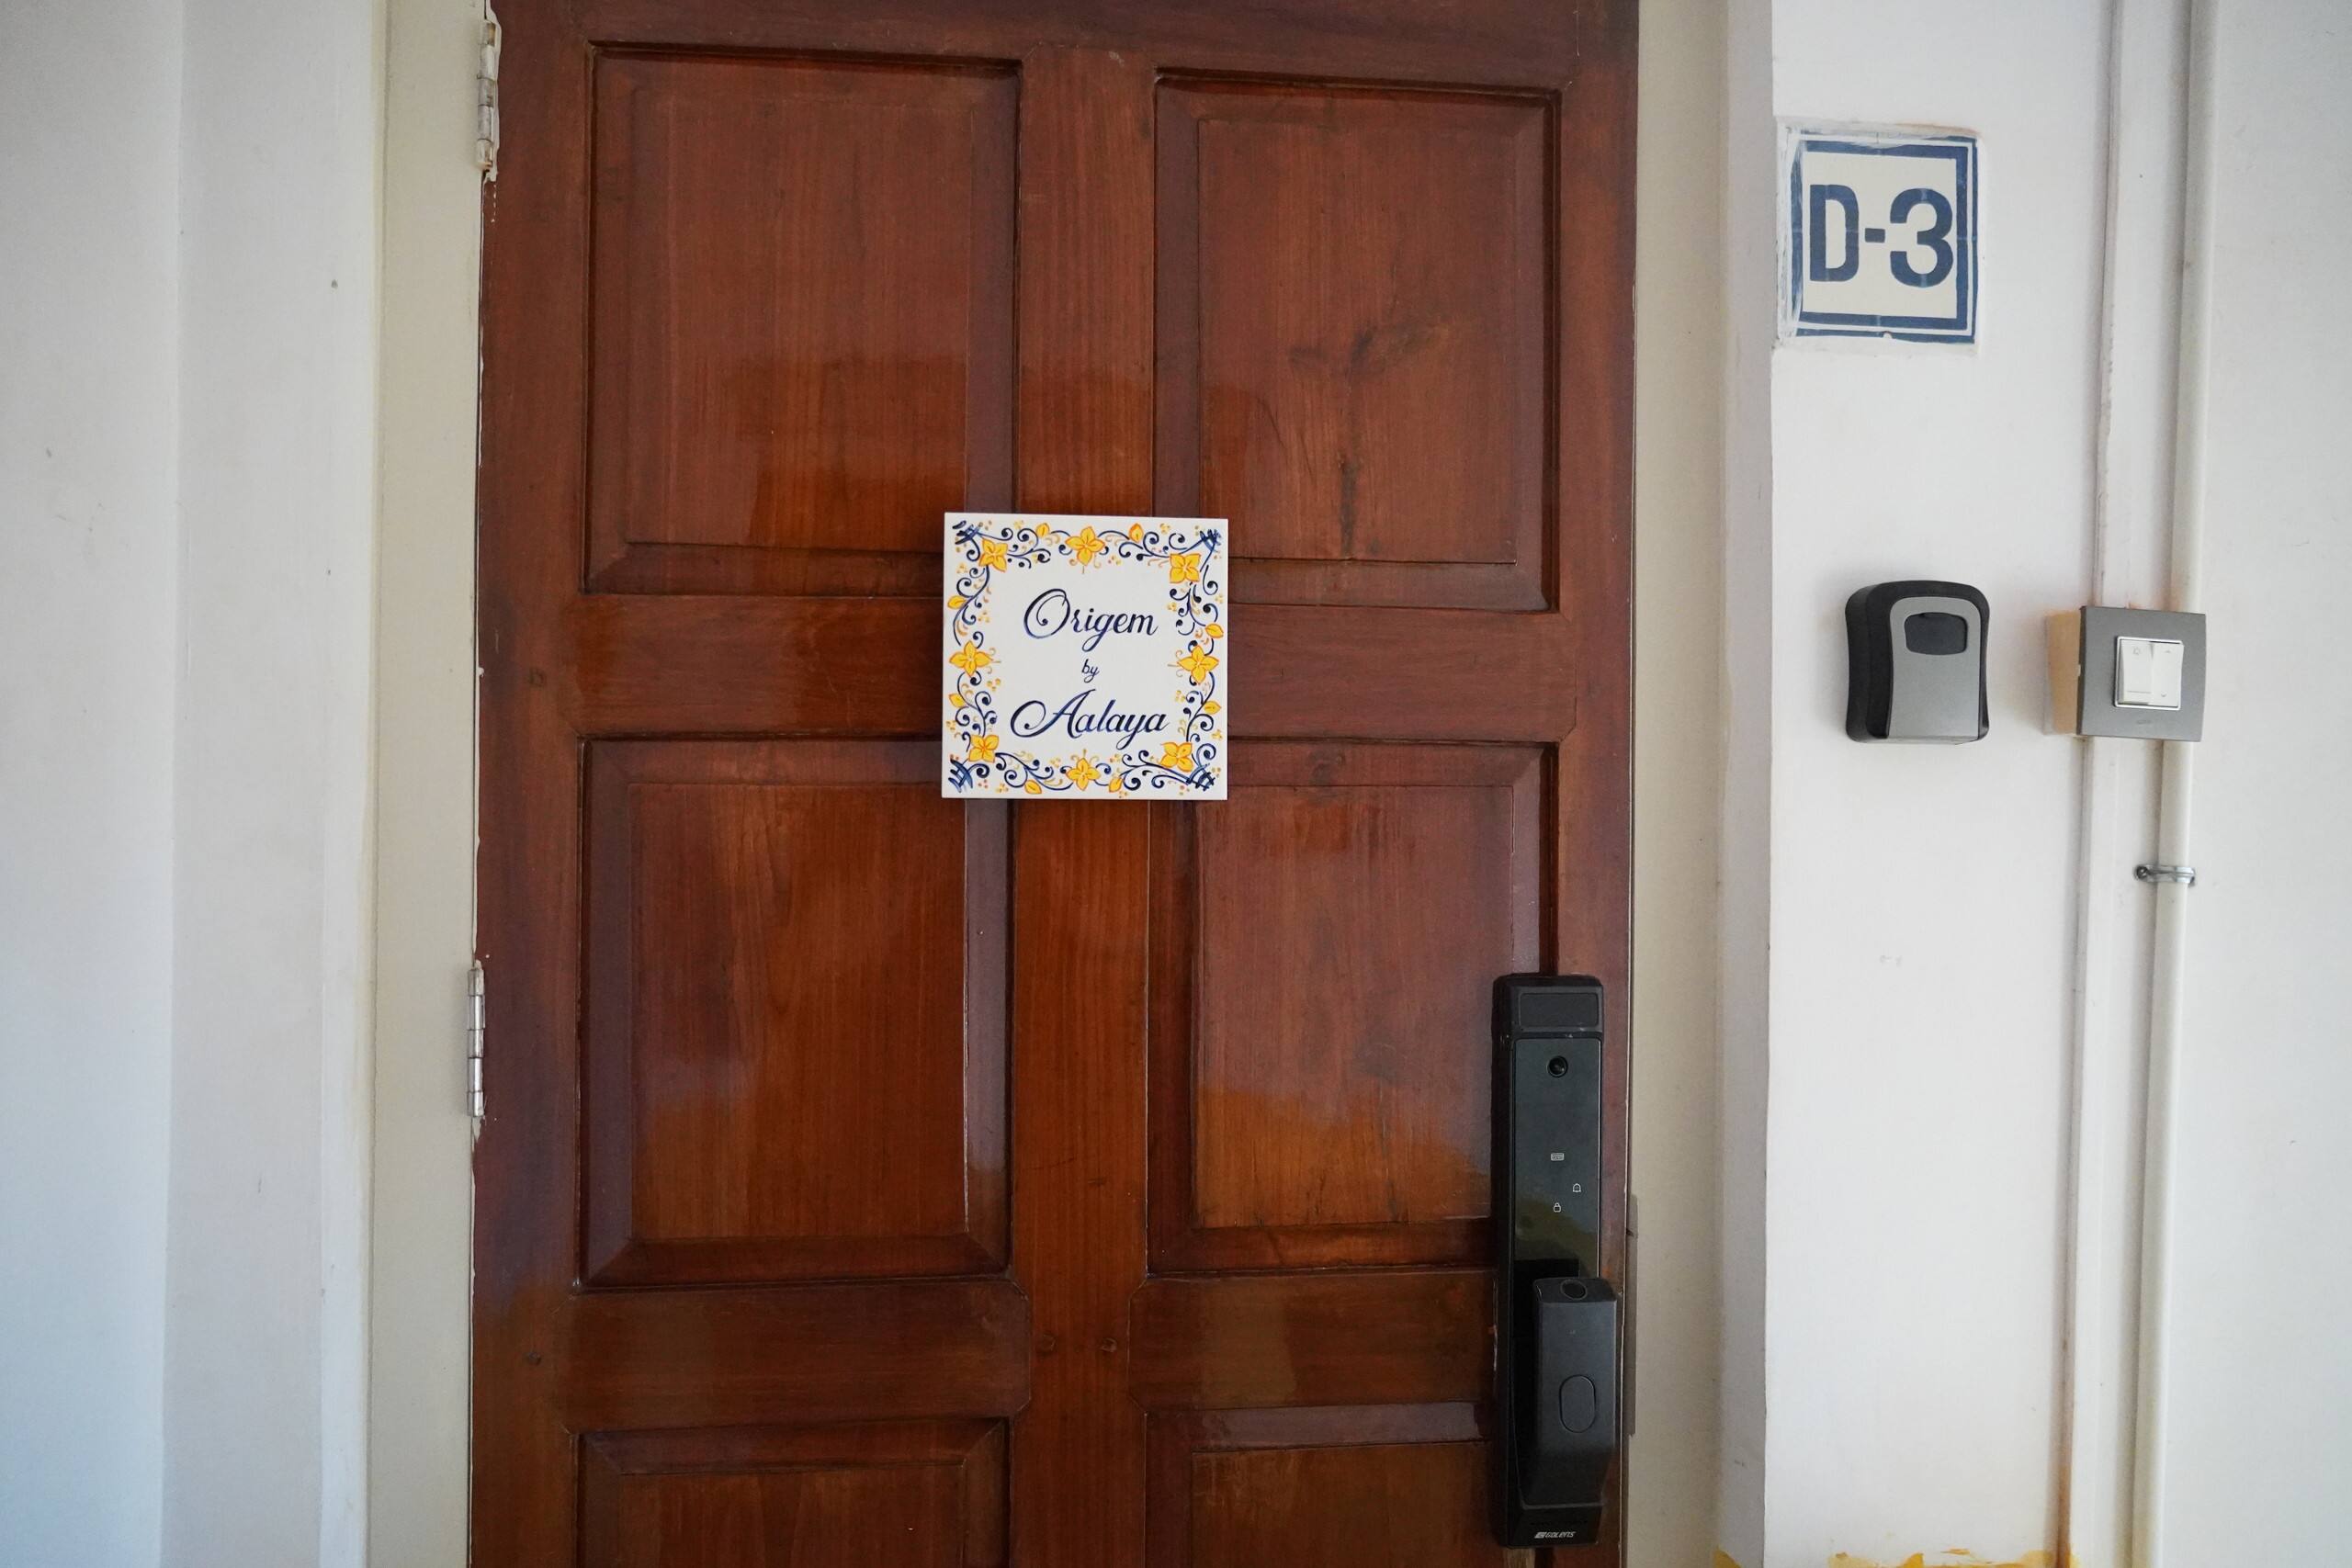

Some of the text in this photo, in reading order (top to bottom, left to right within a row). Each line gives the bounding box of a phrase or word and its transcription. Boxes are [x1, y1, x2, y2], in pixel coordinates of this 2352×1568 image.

[1809, 185, 1953, 288] D-3
[1023, 588, 1159, 652] Origem
[1081, 659, 1100, 683] by
[1011, 689, 1170, 750] Aalaya
